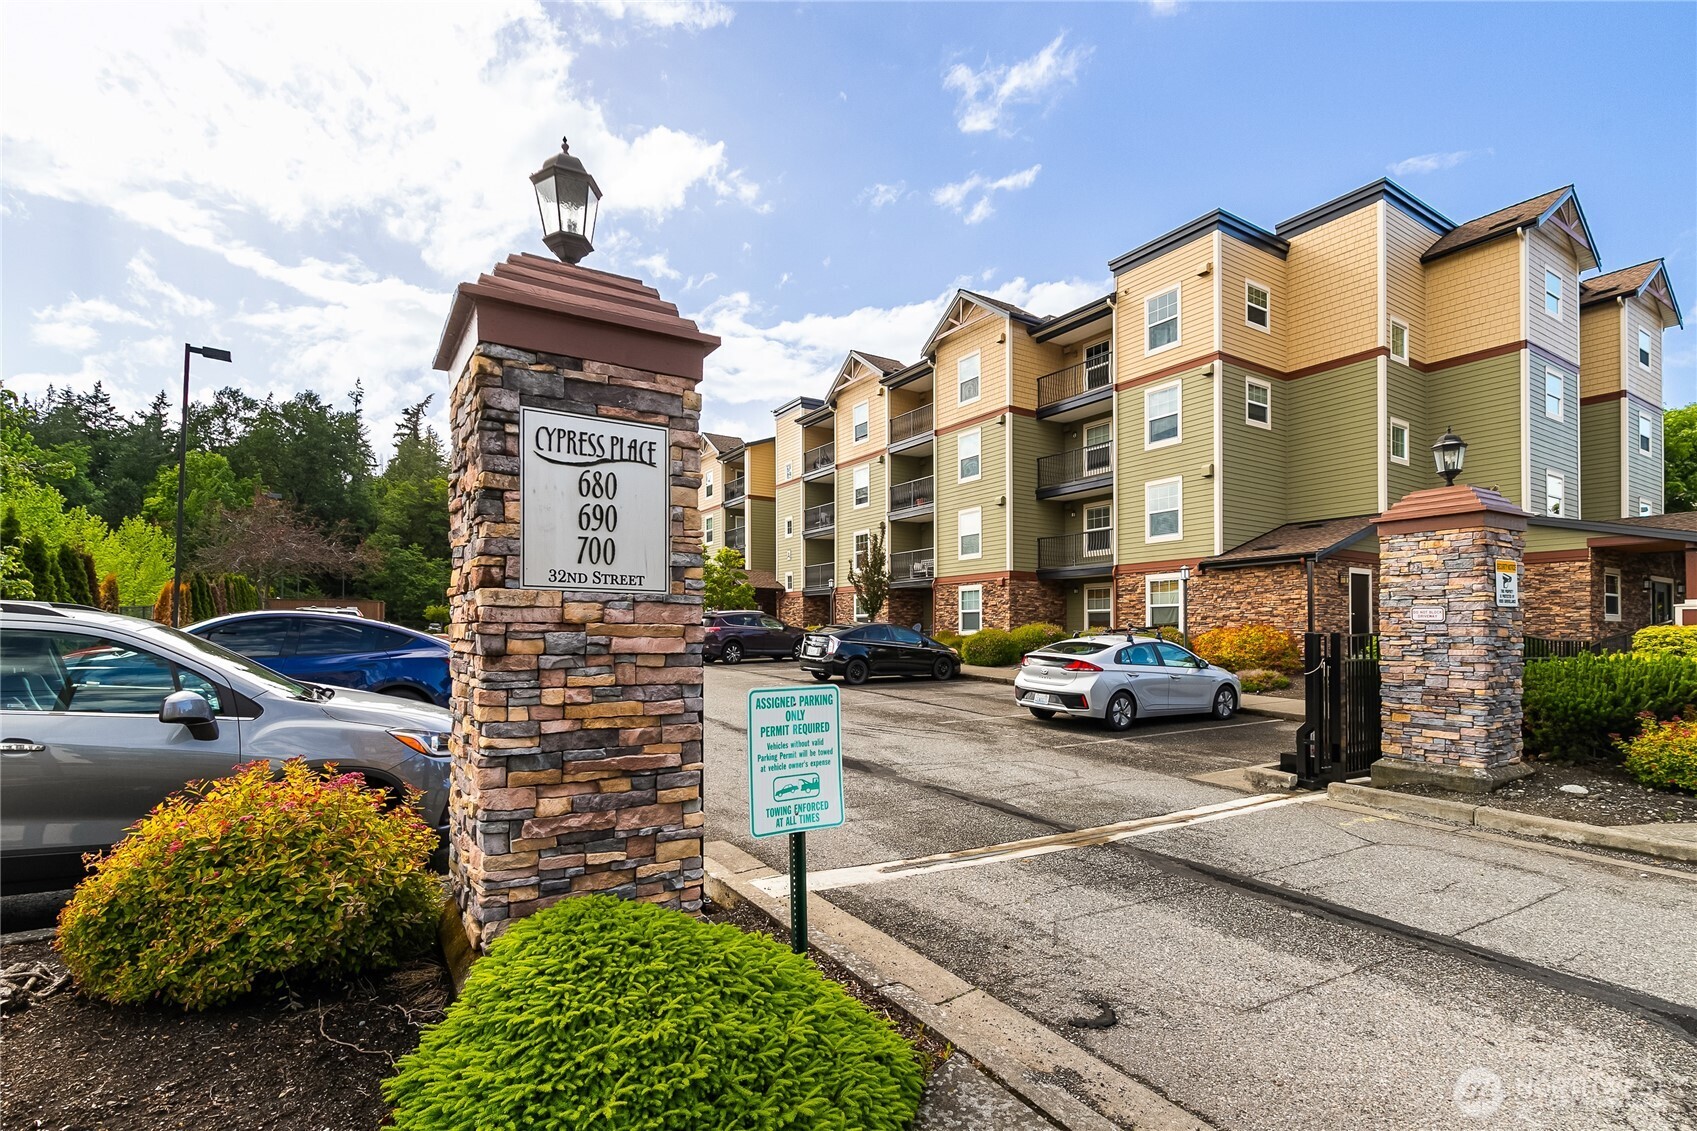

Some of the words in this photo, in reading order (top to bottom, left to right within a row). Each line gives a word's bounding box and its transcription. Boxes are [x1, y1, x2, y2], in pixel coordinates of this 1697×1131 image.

[535, 426, 605, 459] CYPRESS
[611, 436, 656, 464] PLACE
[578, 470, 617, 499] 680
[578, 503, 617, 532] 690
[577, 536, 615, 565] 700
[548, 569, 587, 584] 32ND
[592, 571, 645, 586] STREET
[756, 696, 796, 710] ASSIGNED
[799, 694, 833, 706] PARKING
[786, 710, 805, 722] ONLY
[760, 724, 789, 737] PERMIT
[793, 722, 829, 735] REQUIRED
[767, 740, 788, 750] Vehicles
[790, 739, 809, 748] without
[812, 738, 824, 746] valid
[757, 753, 777, 763] Parking
[779, 751, 796, 760] Permit
[799, 750, 808, 758] will
[810, 749, 816, 757] be
[818, 748, 833, 756] towed
[761, 764, 766, 772] at
[768, 762, 786, 771] vehicle
[788, 761, 808, 769] owner's
[811, 759, 830, 768] expense
[766, 805, 792, 818] TOWING
[794, 801, 829, 814] ENFORCED
[776, 818, 783, 828] AT
[786, 815, 796, 826] ALL
[799, 813, 820, 823] TIMES
